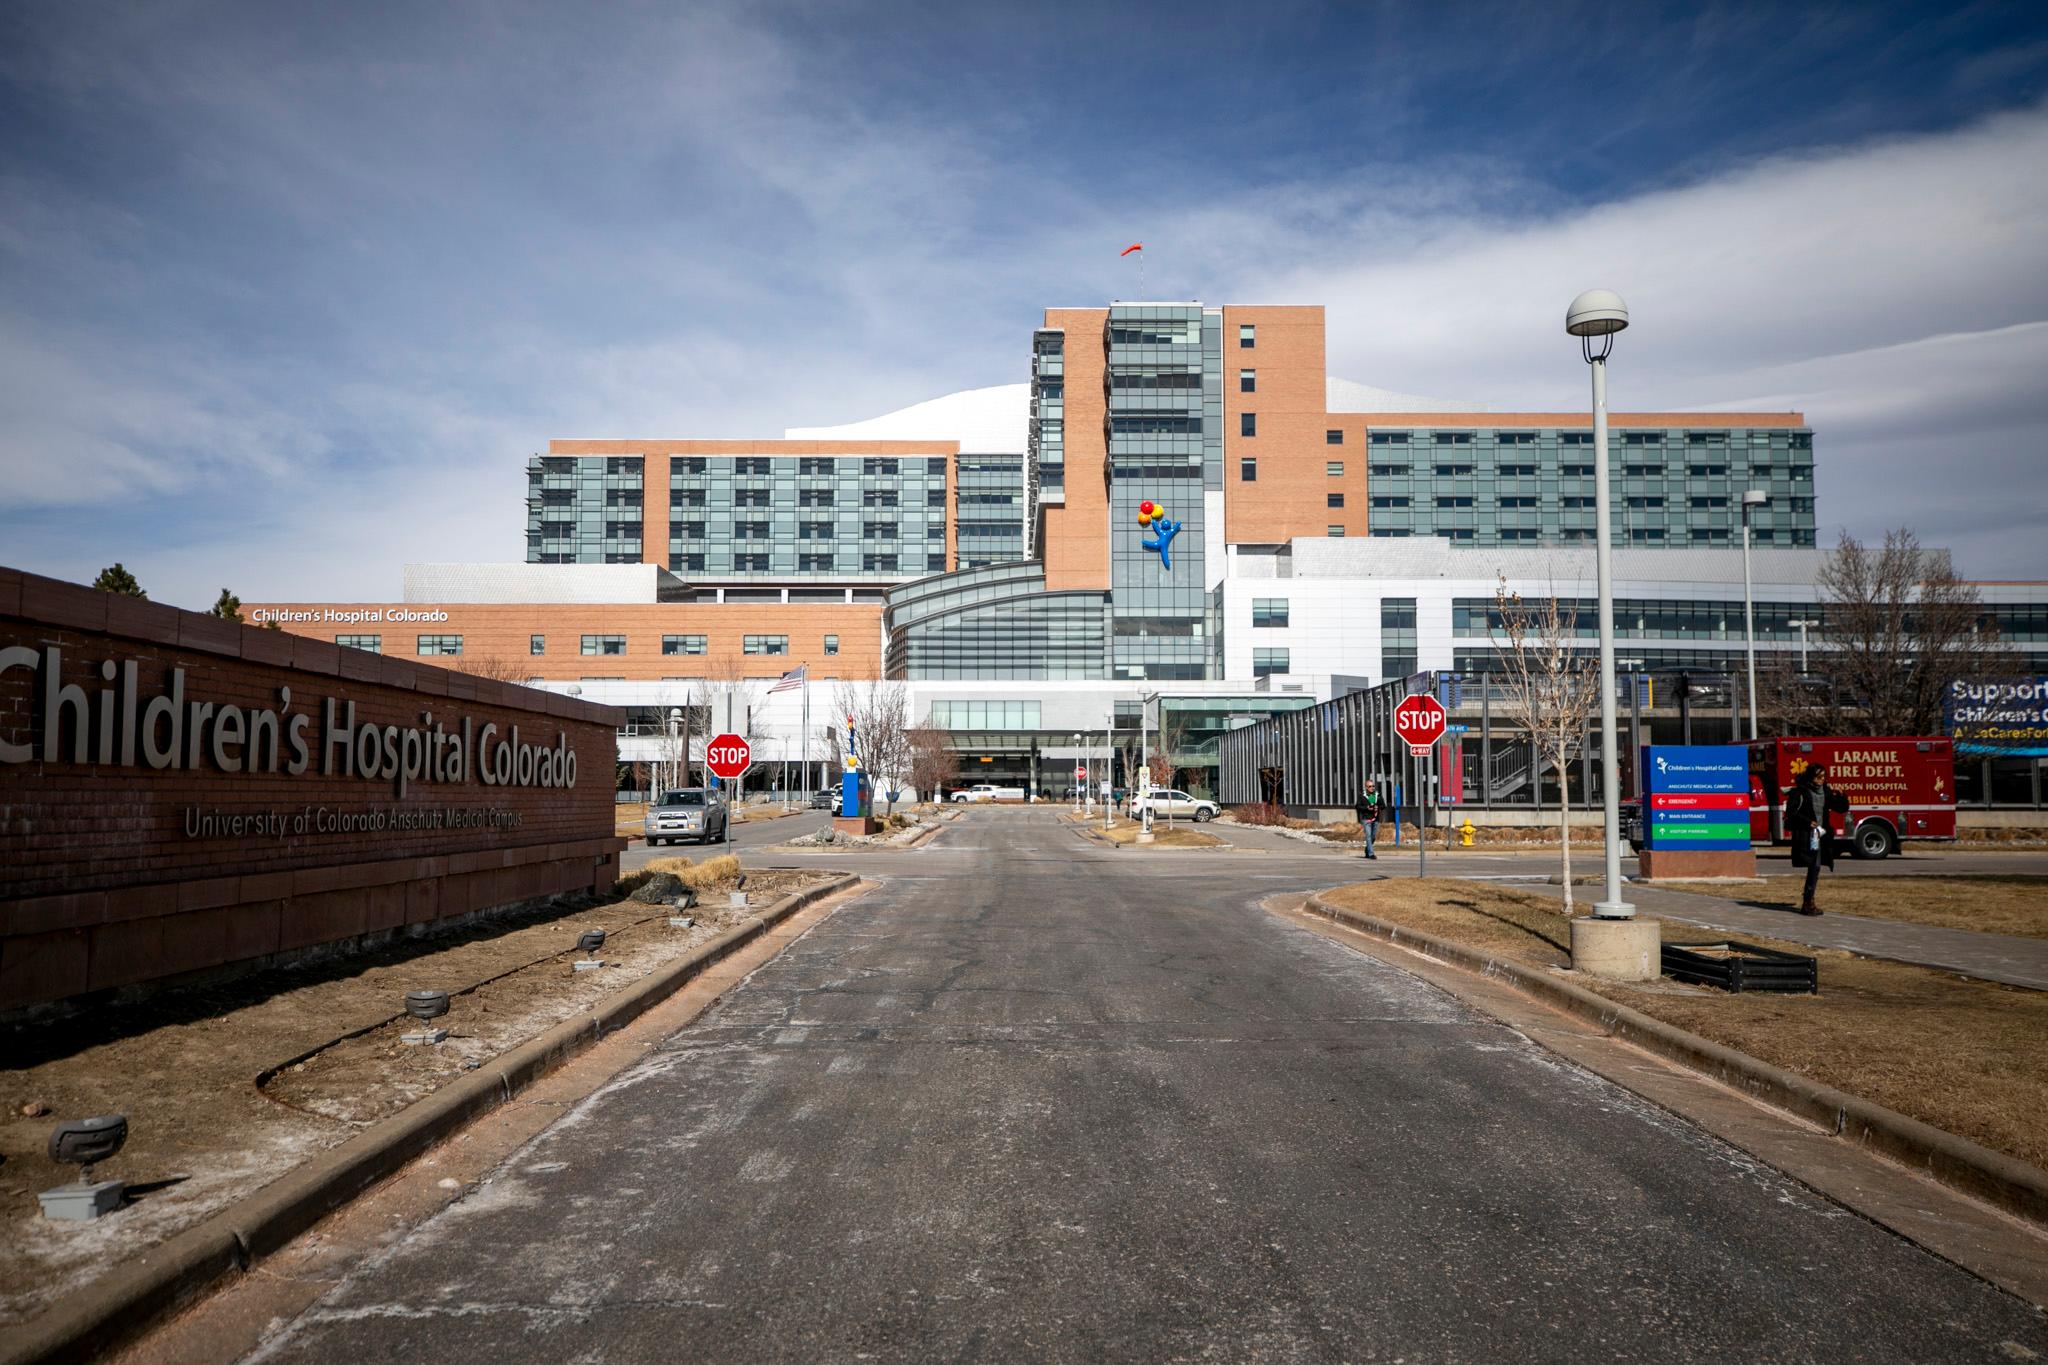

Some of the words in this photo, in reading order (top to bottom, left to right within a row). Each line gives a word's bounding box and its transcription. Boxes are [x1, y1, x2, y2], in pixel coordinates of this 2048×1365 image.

[252, 608, 321, 622] Children's
[324, 608, 383, 624] Hospital
[386, 609, 449, 622] Colorado
[0, 646, 310, 775] Children's
[324, 697, 471, 799] Hospital
[480, 723, 577, 789] Colorado
[1399, 711, 1442, 729] STOP
[709, 747, 748, 765] STOP
[1834, 751, 1898, 763] LARAMIE
[1695, 764, 1717, 772] Hospital
[1829, 765, 1860, 777] FIRE
[1865, 765, 1905, 777] DEPT.
[1865, 782, 1908, 791] HOSPITAL
[1848, 795, 1901, 804] BULANCE
[185, 807, 287, 841] University
[294, 806, 311, 834] of
[317, 806, 386, 833] Colorado
[389, 807, 442, 829] Anschutz
[446, 807, 486, 828] Medical
[488, 808, 523, 828] Campus
